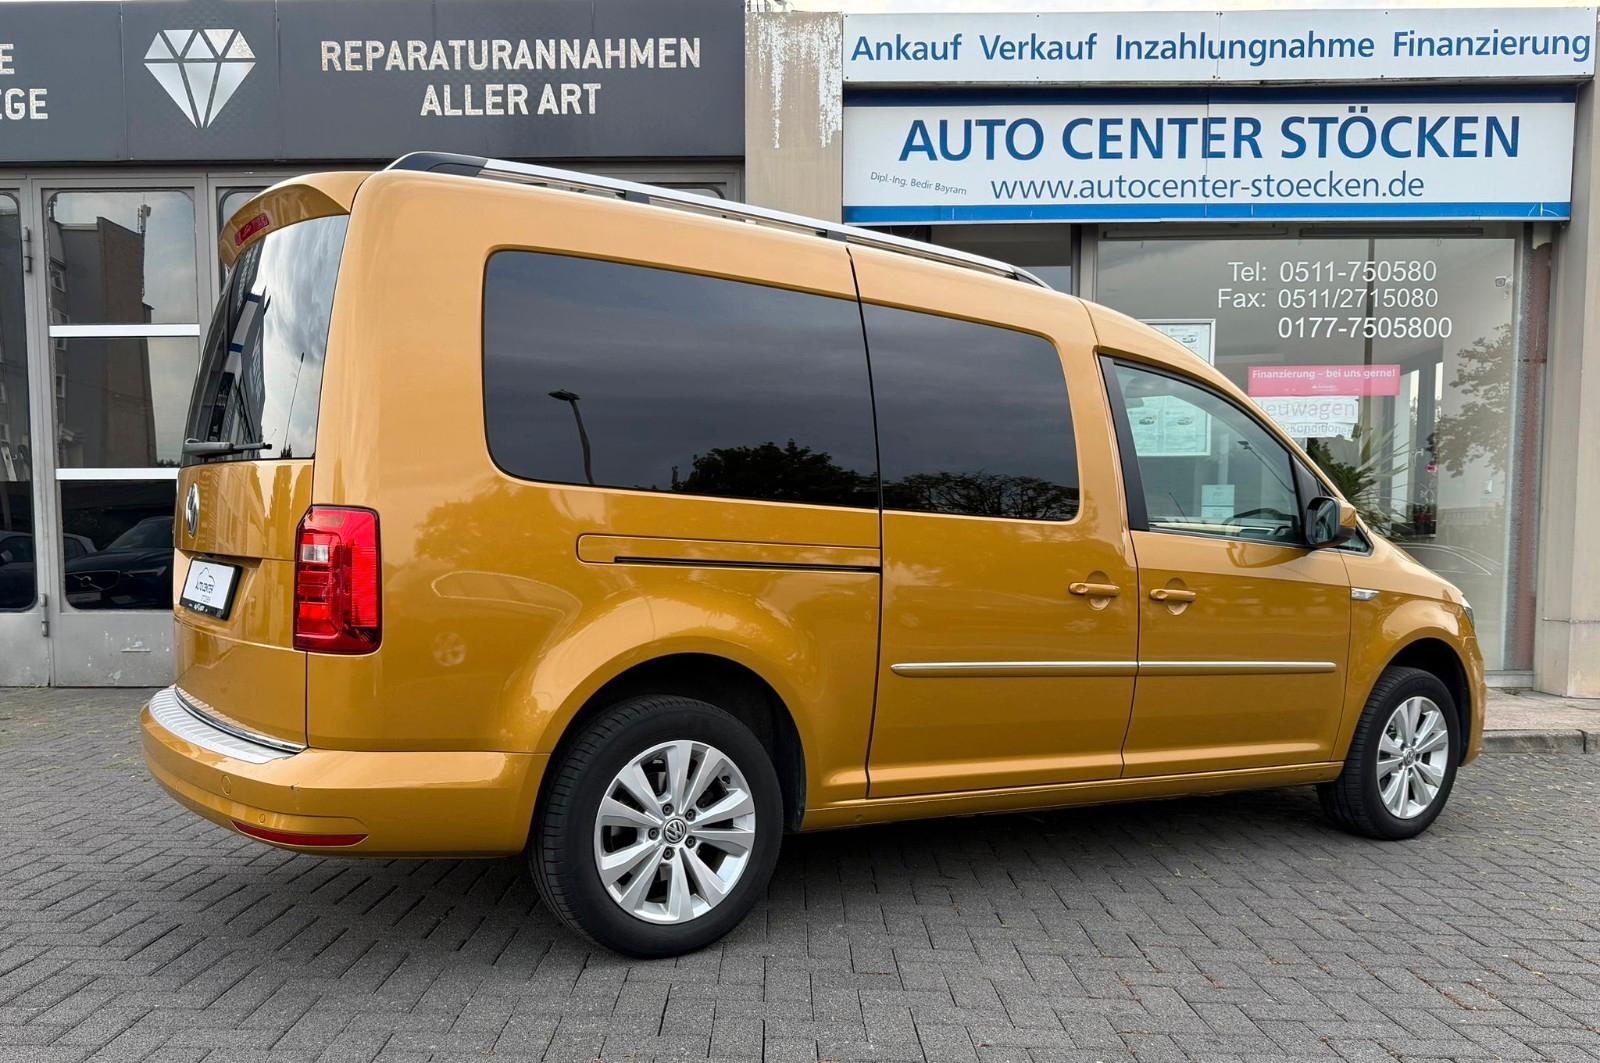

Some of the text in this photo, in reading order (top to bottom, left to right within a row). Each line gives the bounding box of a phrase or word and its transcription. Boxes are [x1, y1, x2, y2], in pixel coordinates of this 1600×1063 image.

[321, 37, 701, 71] REPARATURANNAHMEN
[851, 29, 1591, 66] Ankauf Verkauf Inzahlungnahme Finanzierung
[0, 87, 49, 120] GE
[420, 82, 602, 116] ALLER ART
[899, 105, 1520, 161] AUTO CENTER STÖCKEN
[870, 171, 967, 195] Dipl.-Ing. Bedir Bayram
[990, 169, 1425, 199] www.autocenter-stoecken.de
[1228, 260, 1437, 283] Tel: 0511-750580
[1217, 287, 1439, 309] Fax: 0511/2715080
[1277, 316, 1453, 338] 0177-7505800
[1252, 369, 1316, 380] Finanzierung
[1326, 368, 1342, 378] bei
[1344, 369, 1361, 378] uns
[1363, 369, 1396, 380] gerne!
